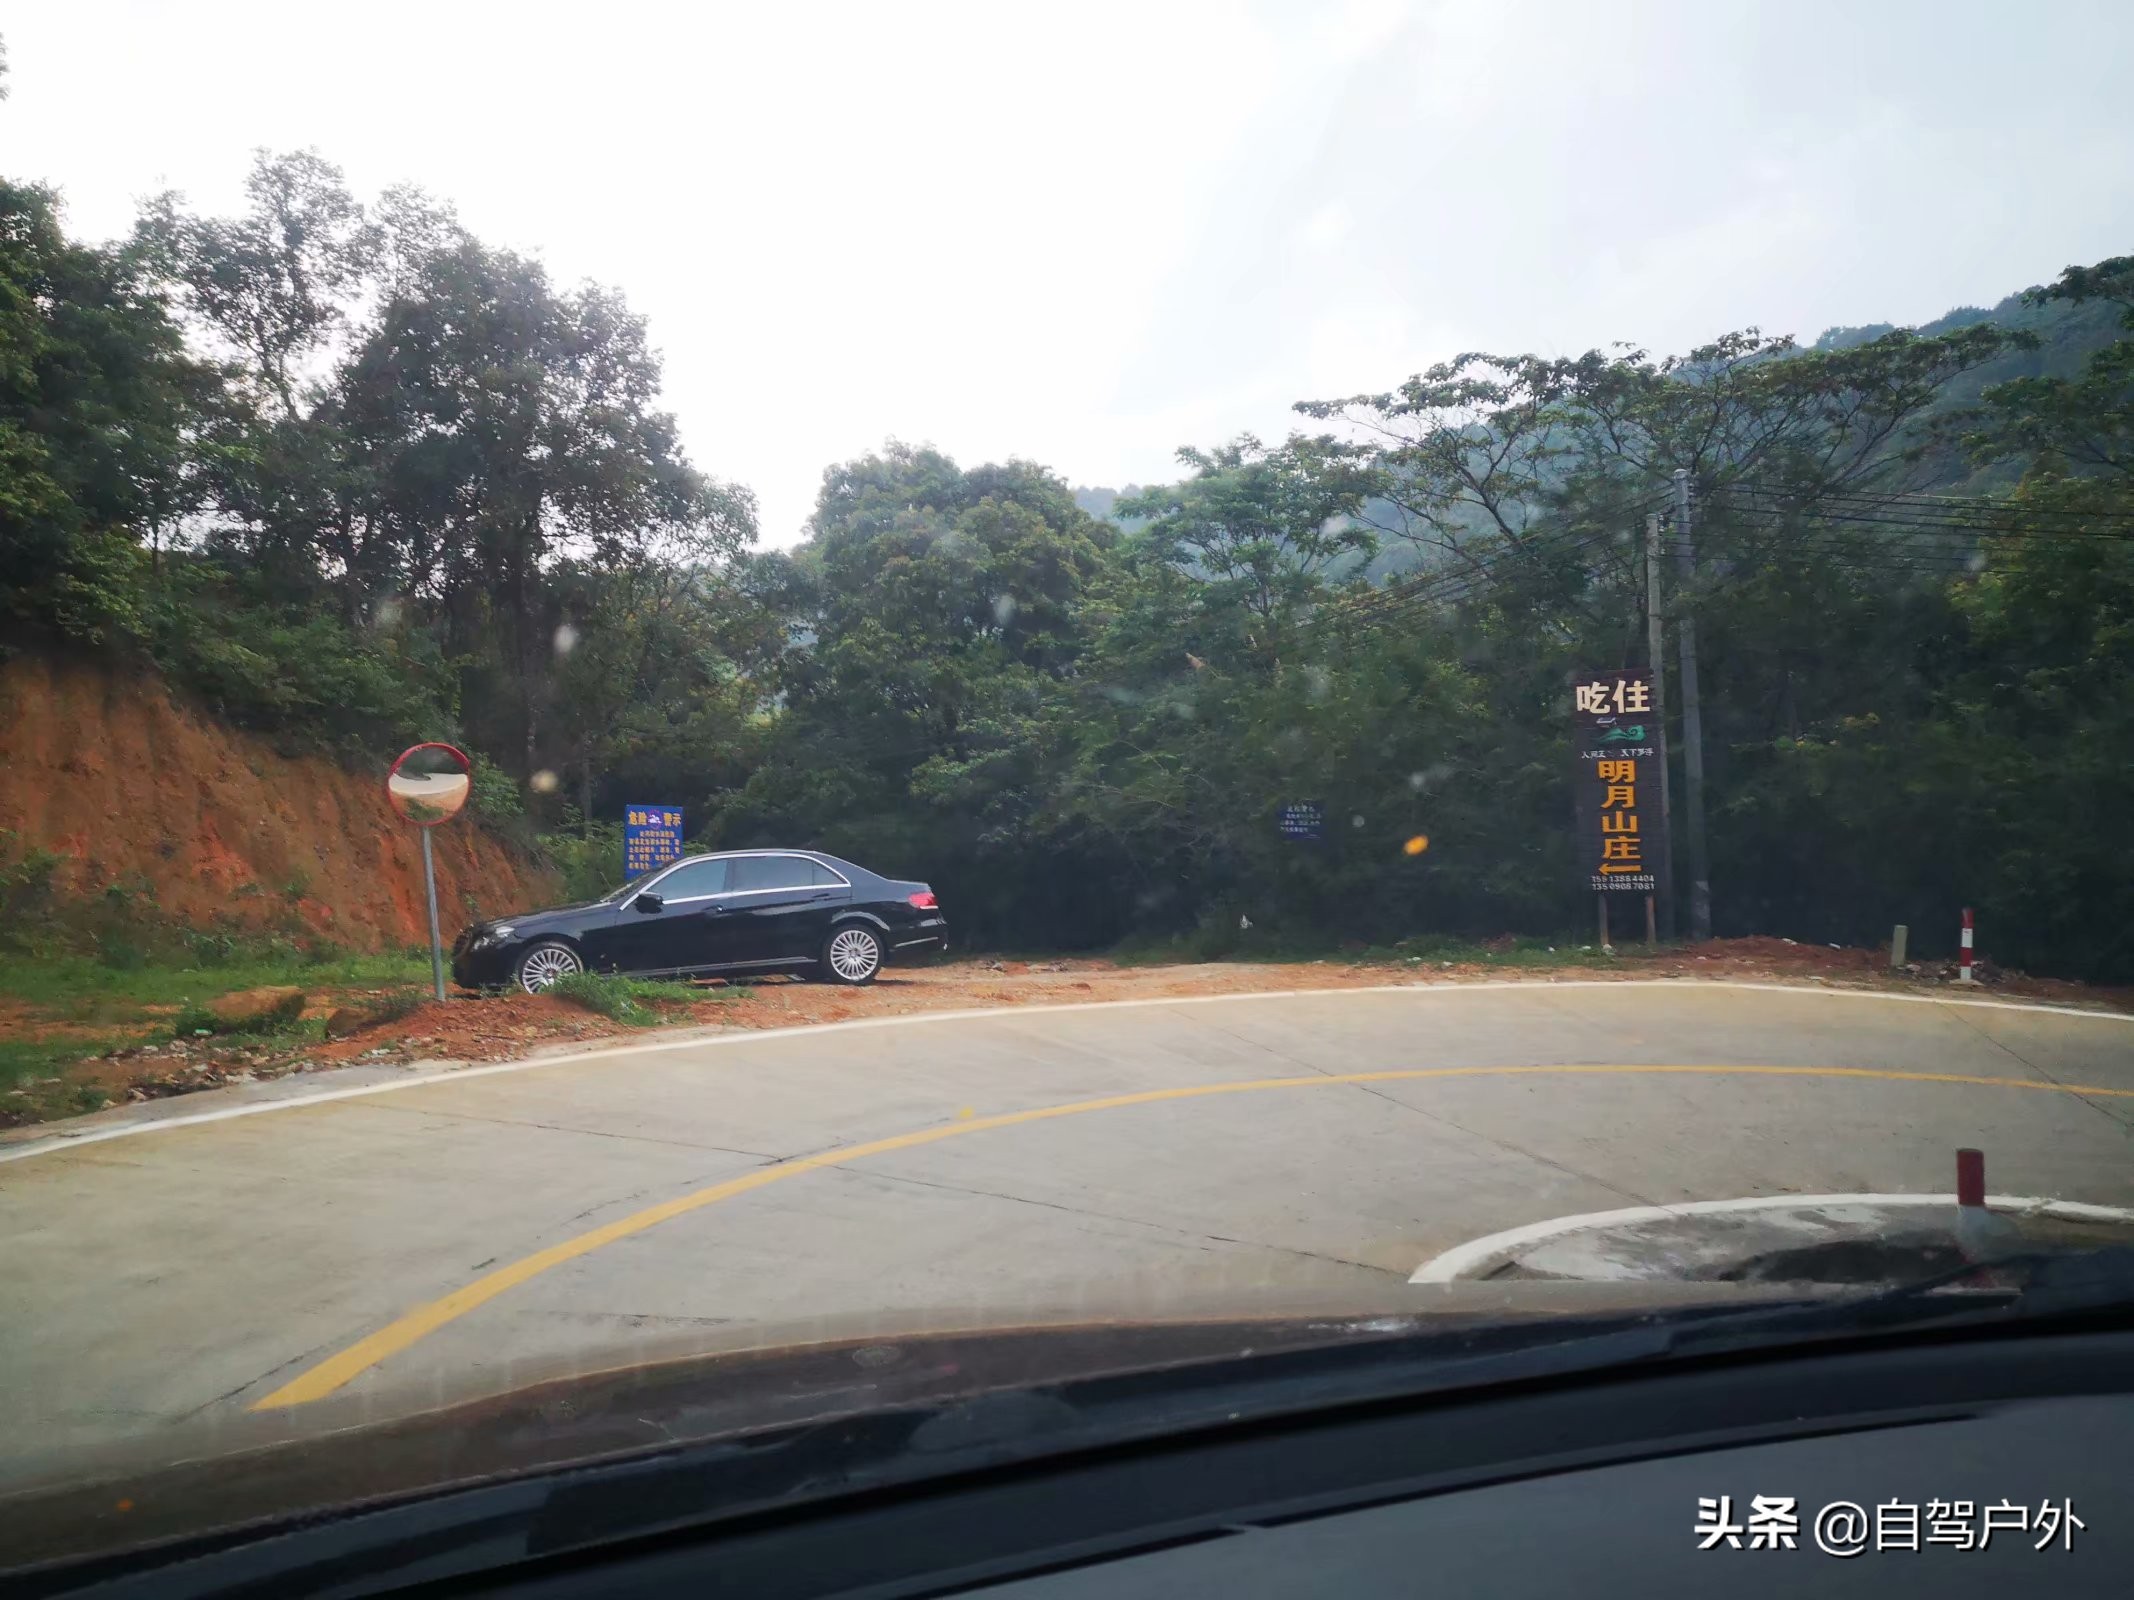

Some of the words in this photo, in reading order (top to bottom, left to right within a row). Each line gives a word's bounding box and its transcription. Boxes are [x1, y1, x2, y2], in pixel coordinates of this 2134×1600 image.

[1576, 680, 1650, 714] 吃住
[1598, 760, 1641, 859] 明月山庄
